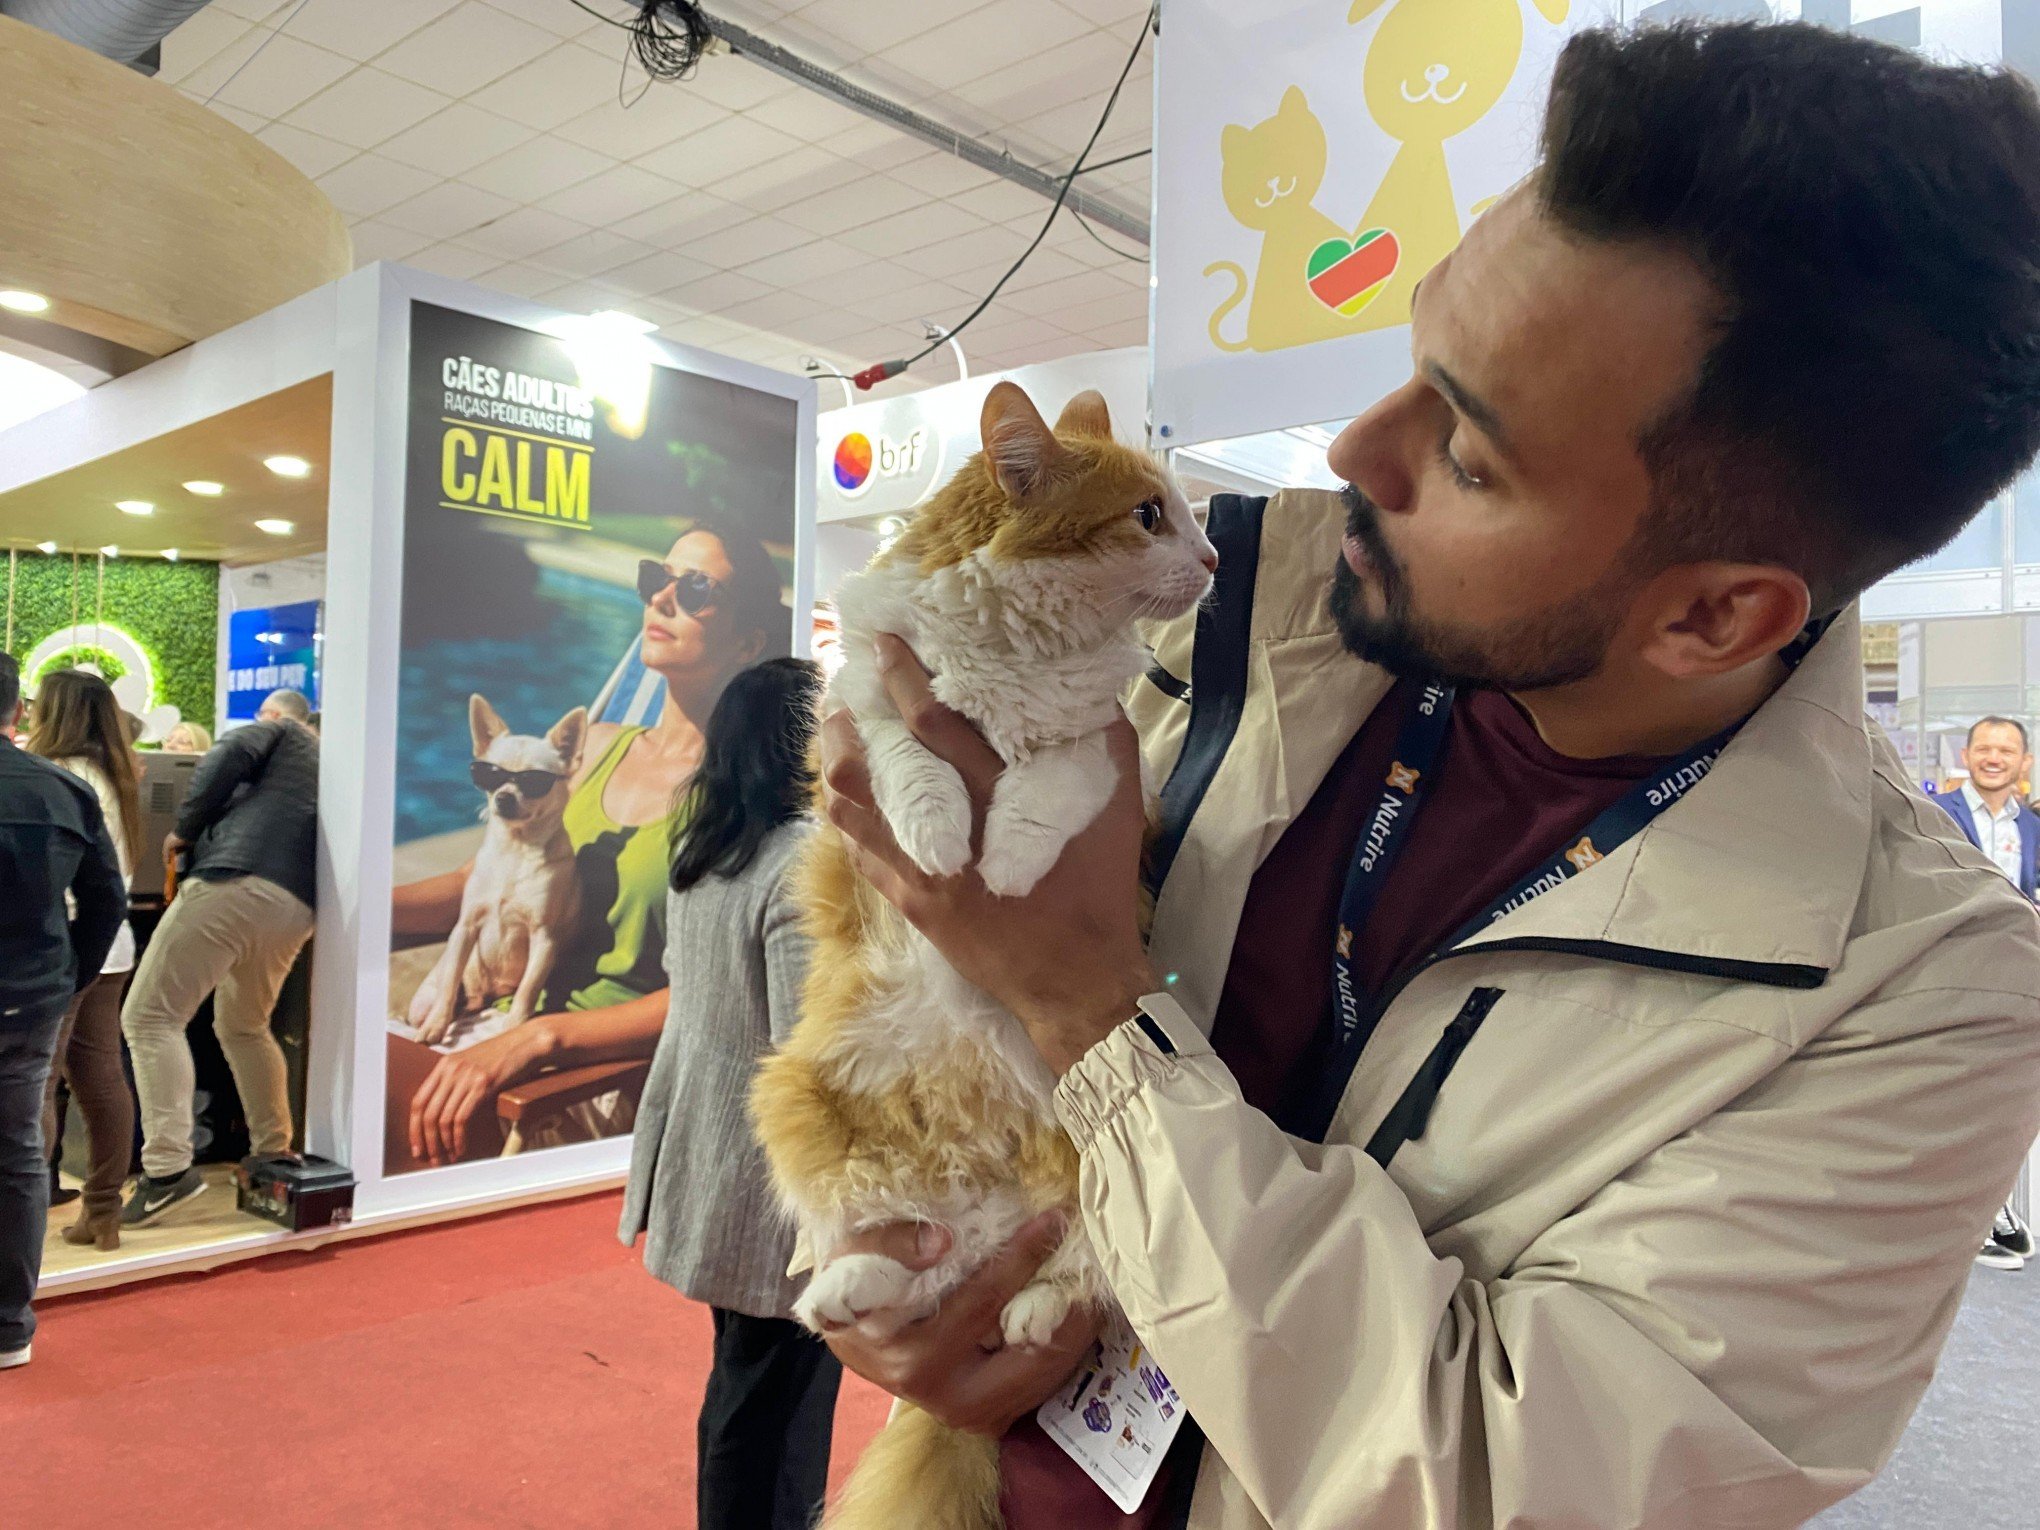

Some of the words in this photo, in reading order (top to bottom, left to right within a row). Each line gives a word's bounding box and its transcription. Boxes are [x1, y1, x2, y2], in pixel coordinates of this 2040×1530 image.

[443, 356, 501, 398] CÃES
[444, 391, 490, 418] RAÇAS
[491, 401, 557, 433] PEQUENAS
[556, 415, 565, 434] E
[880, 431, 920, 470] brf
[441, 427, 591, 521] CALM
[1360, 793, 1402, 872] Nutrire
